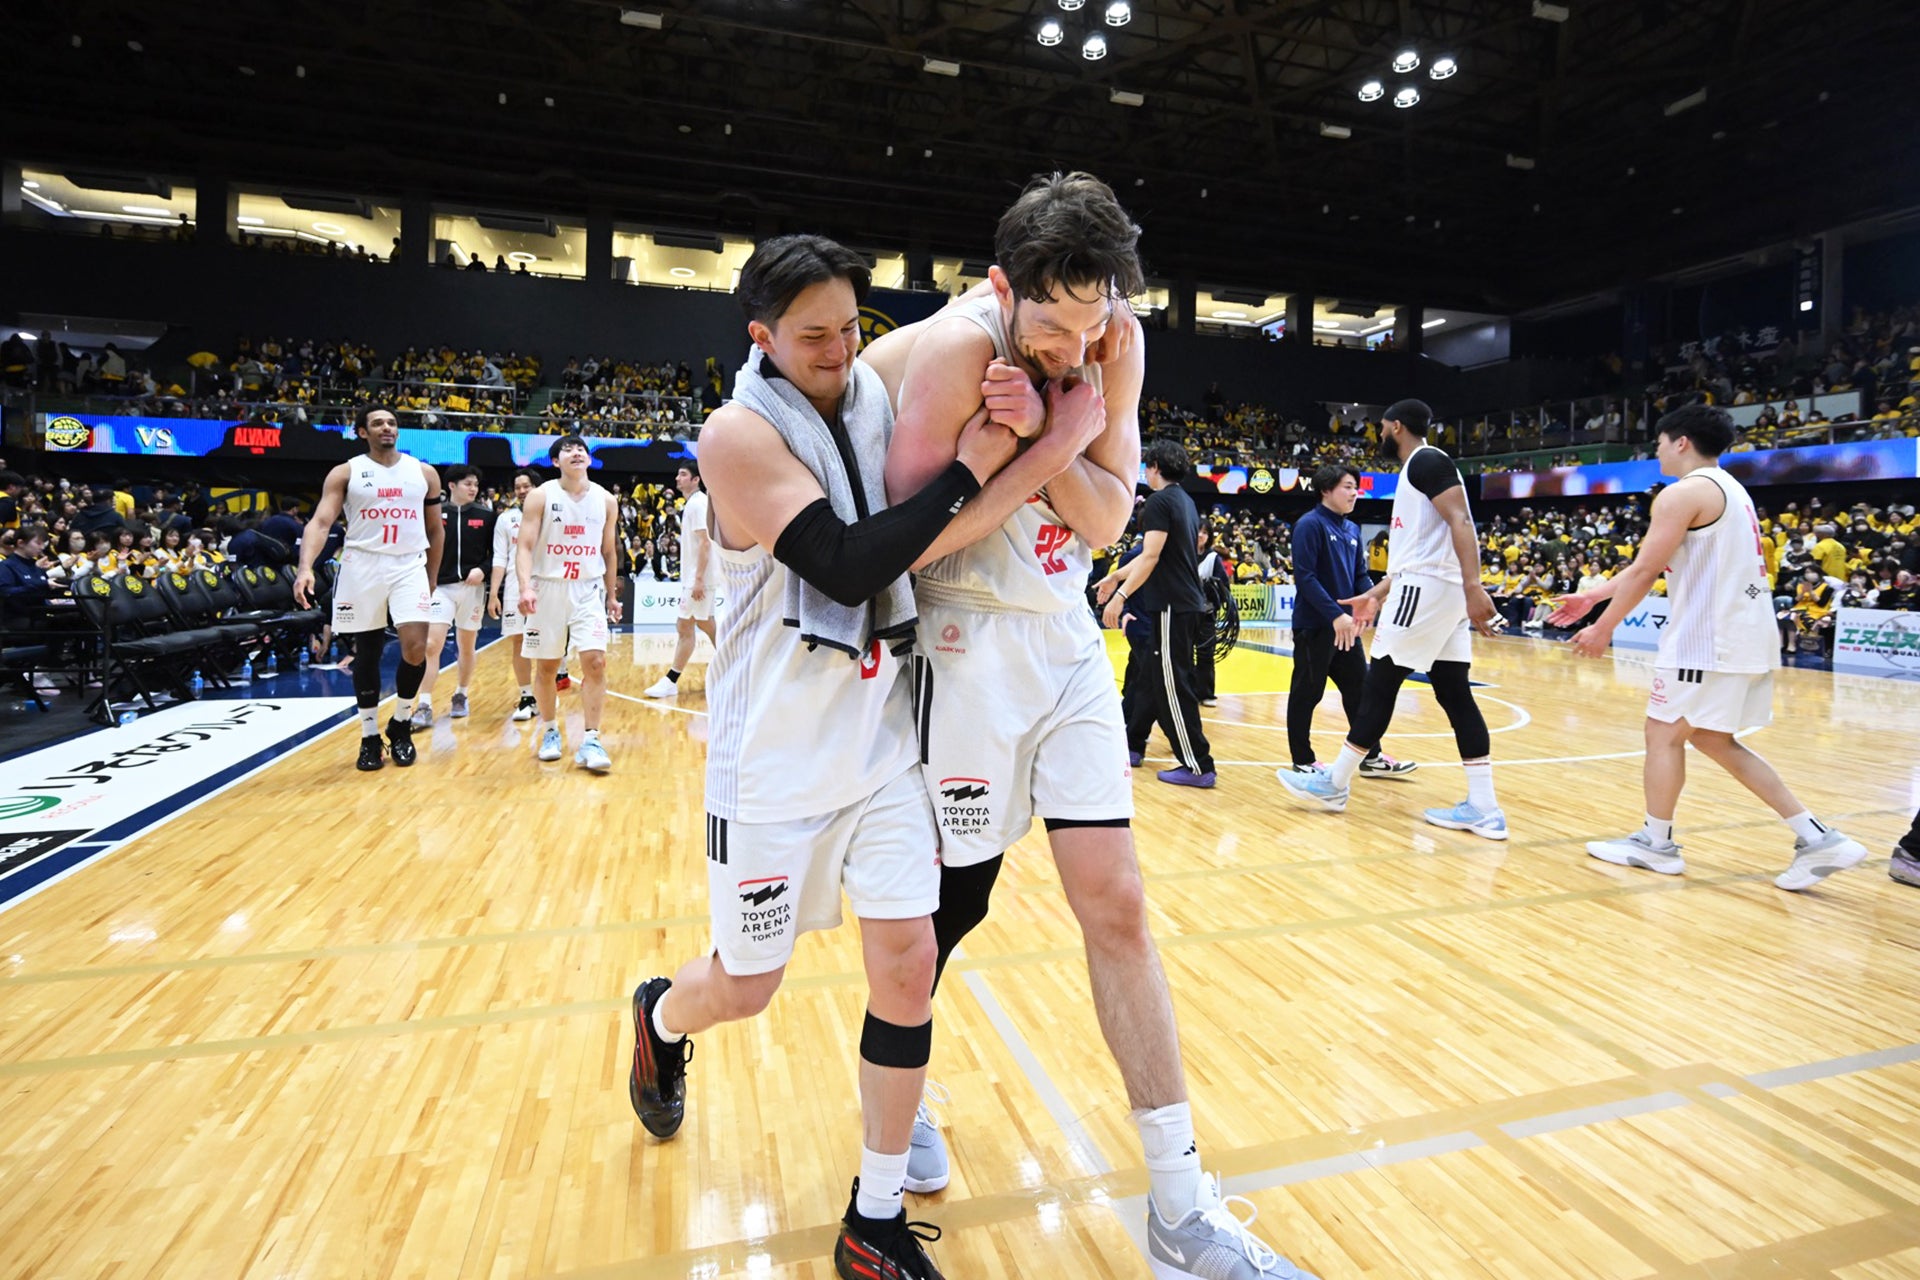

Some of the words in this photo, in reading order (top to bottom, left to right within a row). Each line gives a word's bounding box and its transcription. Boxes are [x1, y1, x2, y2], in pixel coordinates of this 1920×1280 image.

[136, 427, 173, 448] VS
[234, 427, 281, 447] ALVARK
[377, 487, 403, 498] ALVARK
[360, 507, 418, 521] TOYOTA
[382, 524, 398, 544] 11
[546, 543, 597, 556] TOYOTA
[563, 561, 580, 579] 75
[942, 806, 990, 816] TOYOTA
[942, 817, 990, 827] ARENA
[950, 828, 982, 836] TOKYO
[741, 903, 791, 921] TOYOTA
[741, 913, 791, 933] ARENA
[752, 928, 784, 942] TOKYO
